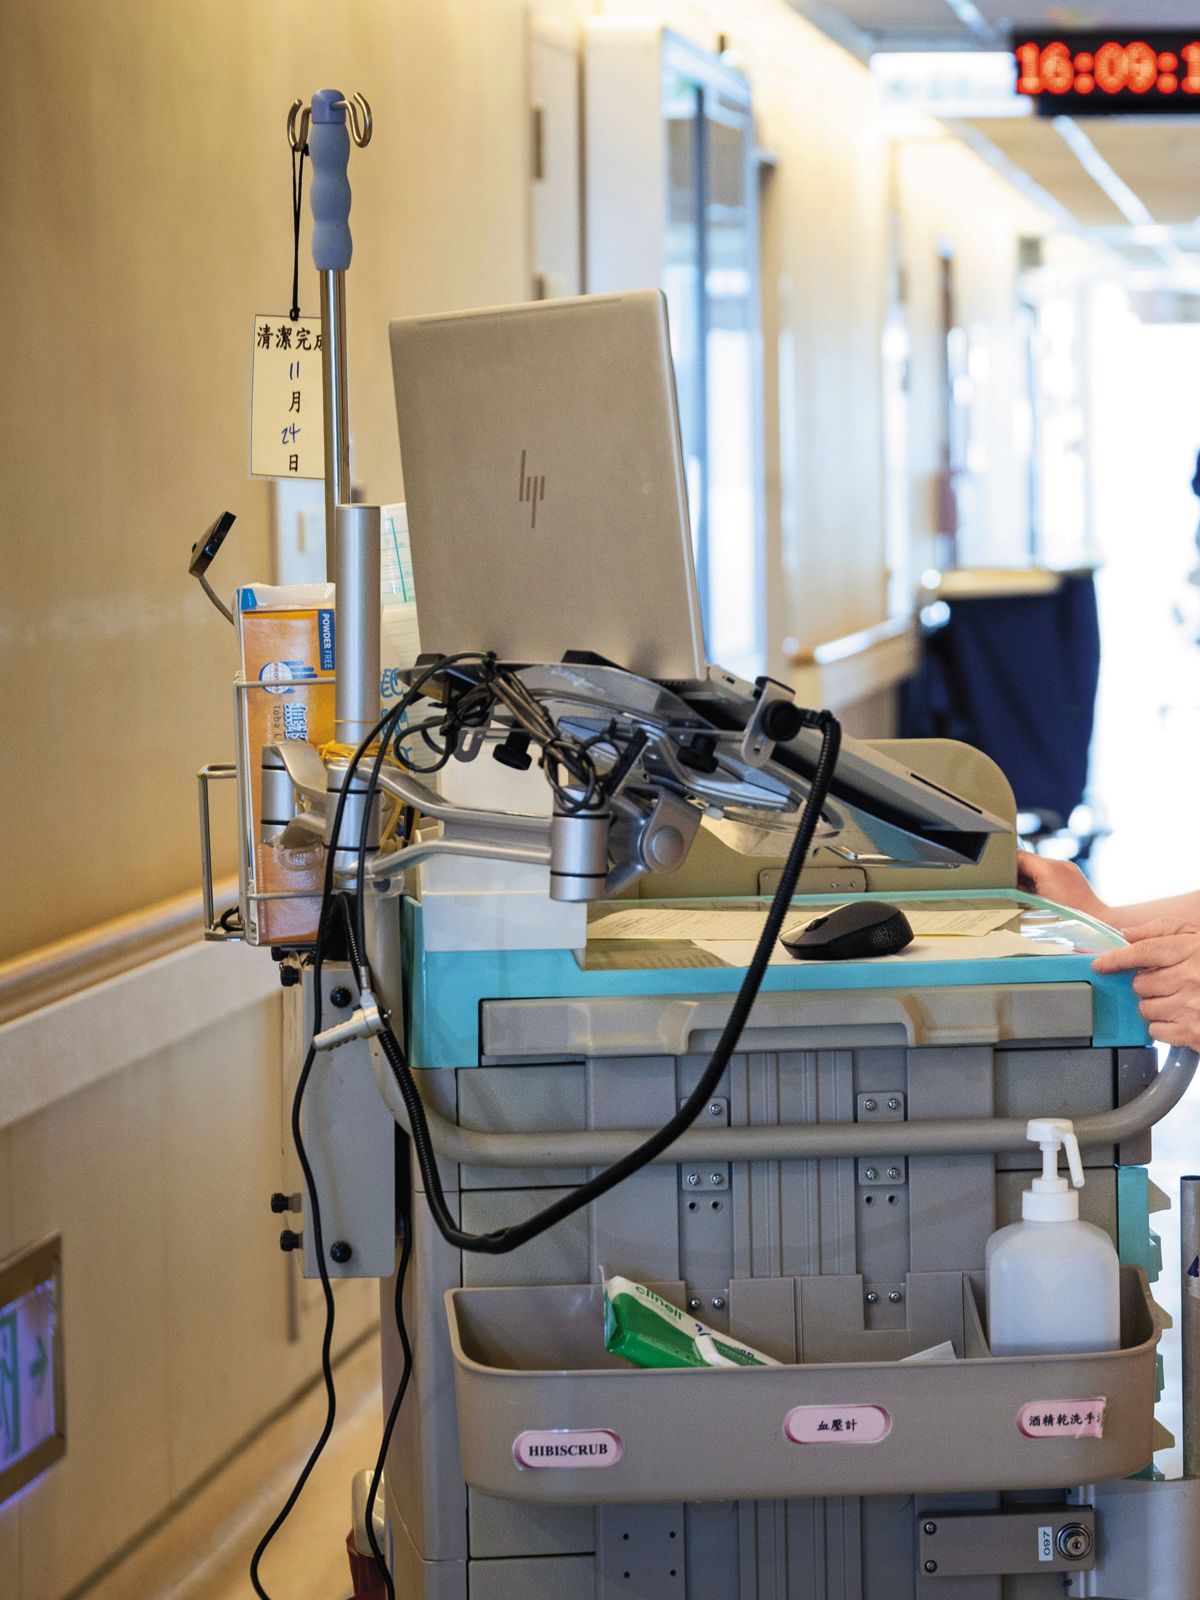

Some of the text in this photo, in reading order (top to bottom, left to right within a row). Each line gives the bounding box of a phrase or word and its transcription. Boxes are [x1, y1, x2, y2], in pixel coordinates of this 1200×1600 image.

[322, 613, 332, 669] POWDER FREE
[634, 1285, 682, 1320] clinell
[817, 1418, 857, 1432] 血壓計
[529, 1443, 608, 1457] HIBISCRUB
